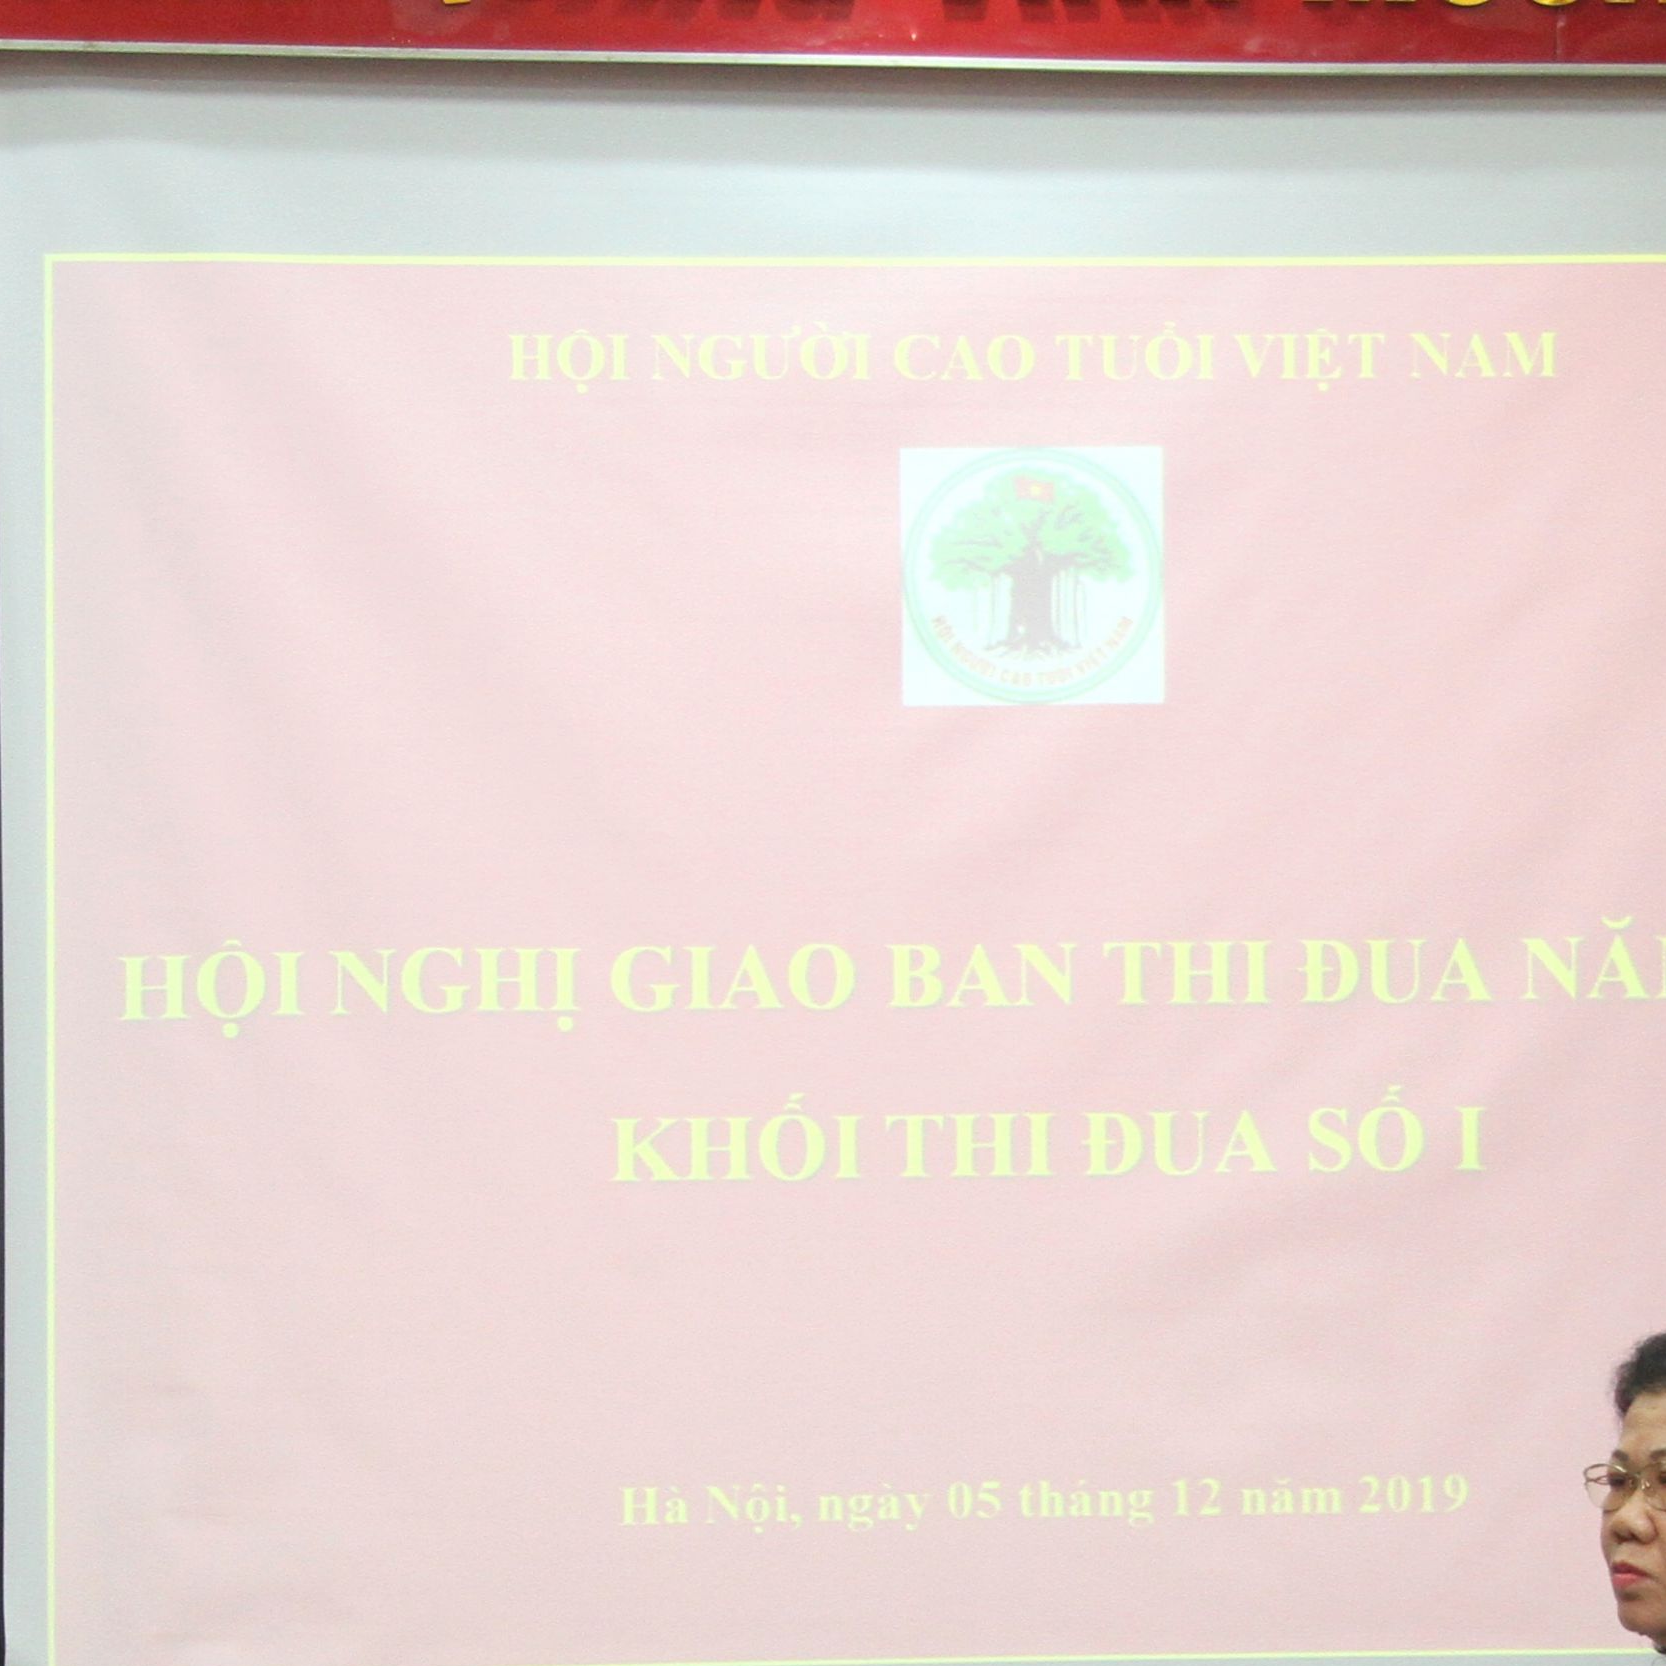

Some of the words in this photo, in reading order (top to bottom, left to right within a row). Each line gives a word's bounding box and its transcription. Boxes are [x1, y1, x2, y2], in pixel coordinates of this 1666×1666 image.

[507, 327, 630, 394] HỘI
[651, 319, 872, 381] NGƯỜI
[893, 333, 1035, 381] CAO
[1055, 320, 1215, 381] TUỔI
[1235, 327, 1386, 392] VIỆT
[1409, 330, 1558, 379] NAM
[119, 938, 304, 1040] HỘI
[328, 946, 581, 1032] NGHỊ
[608, 942, 857, 1012] GIAO
[886, 942, 1078, 1009] BAN
[1102, 939, 1273, 1005] THI
[1297, 936, 1494, 1004] ĐUA
[610, 1092, 864, 1183] KHỐI
[884, 1110, 1056, 1179] THI
[1082, 1109, 1278, 1177] ĐUA
[1306, 1084, 1426, 1174] SỐ
[1455, 1105, 1487, 1173] I
[619, 1485, 689, 1527] Hà
[705, 1484, 803, 1534] Nội,
[817, 1482, 928, 1531] ngày
[946, 1480, 1003, 1520] 05
[1018, 1478, 1156, 1527] tháng
[1175, 1477, 1223, 1518] 12
[1240, 1477, 1346, 1517] năm
[1359, 1474, 1471, 1515] 2019
